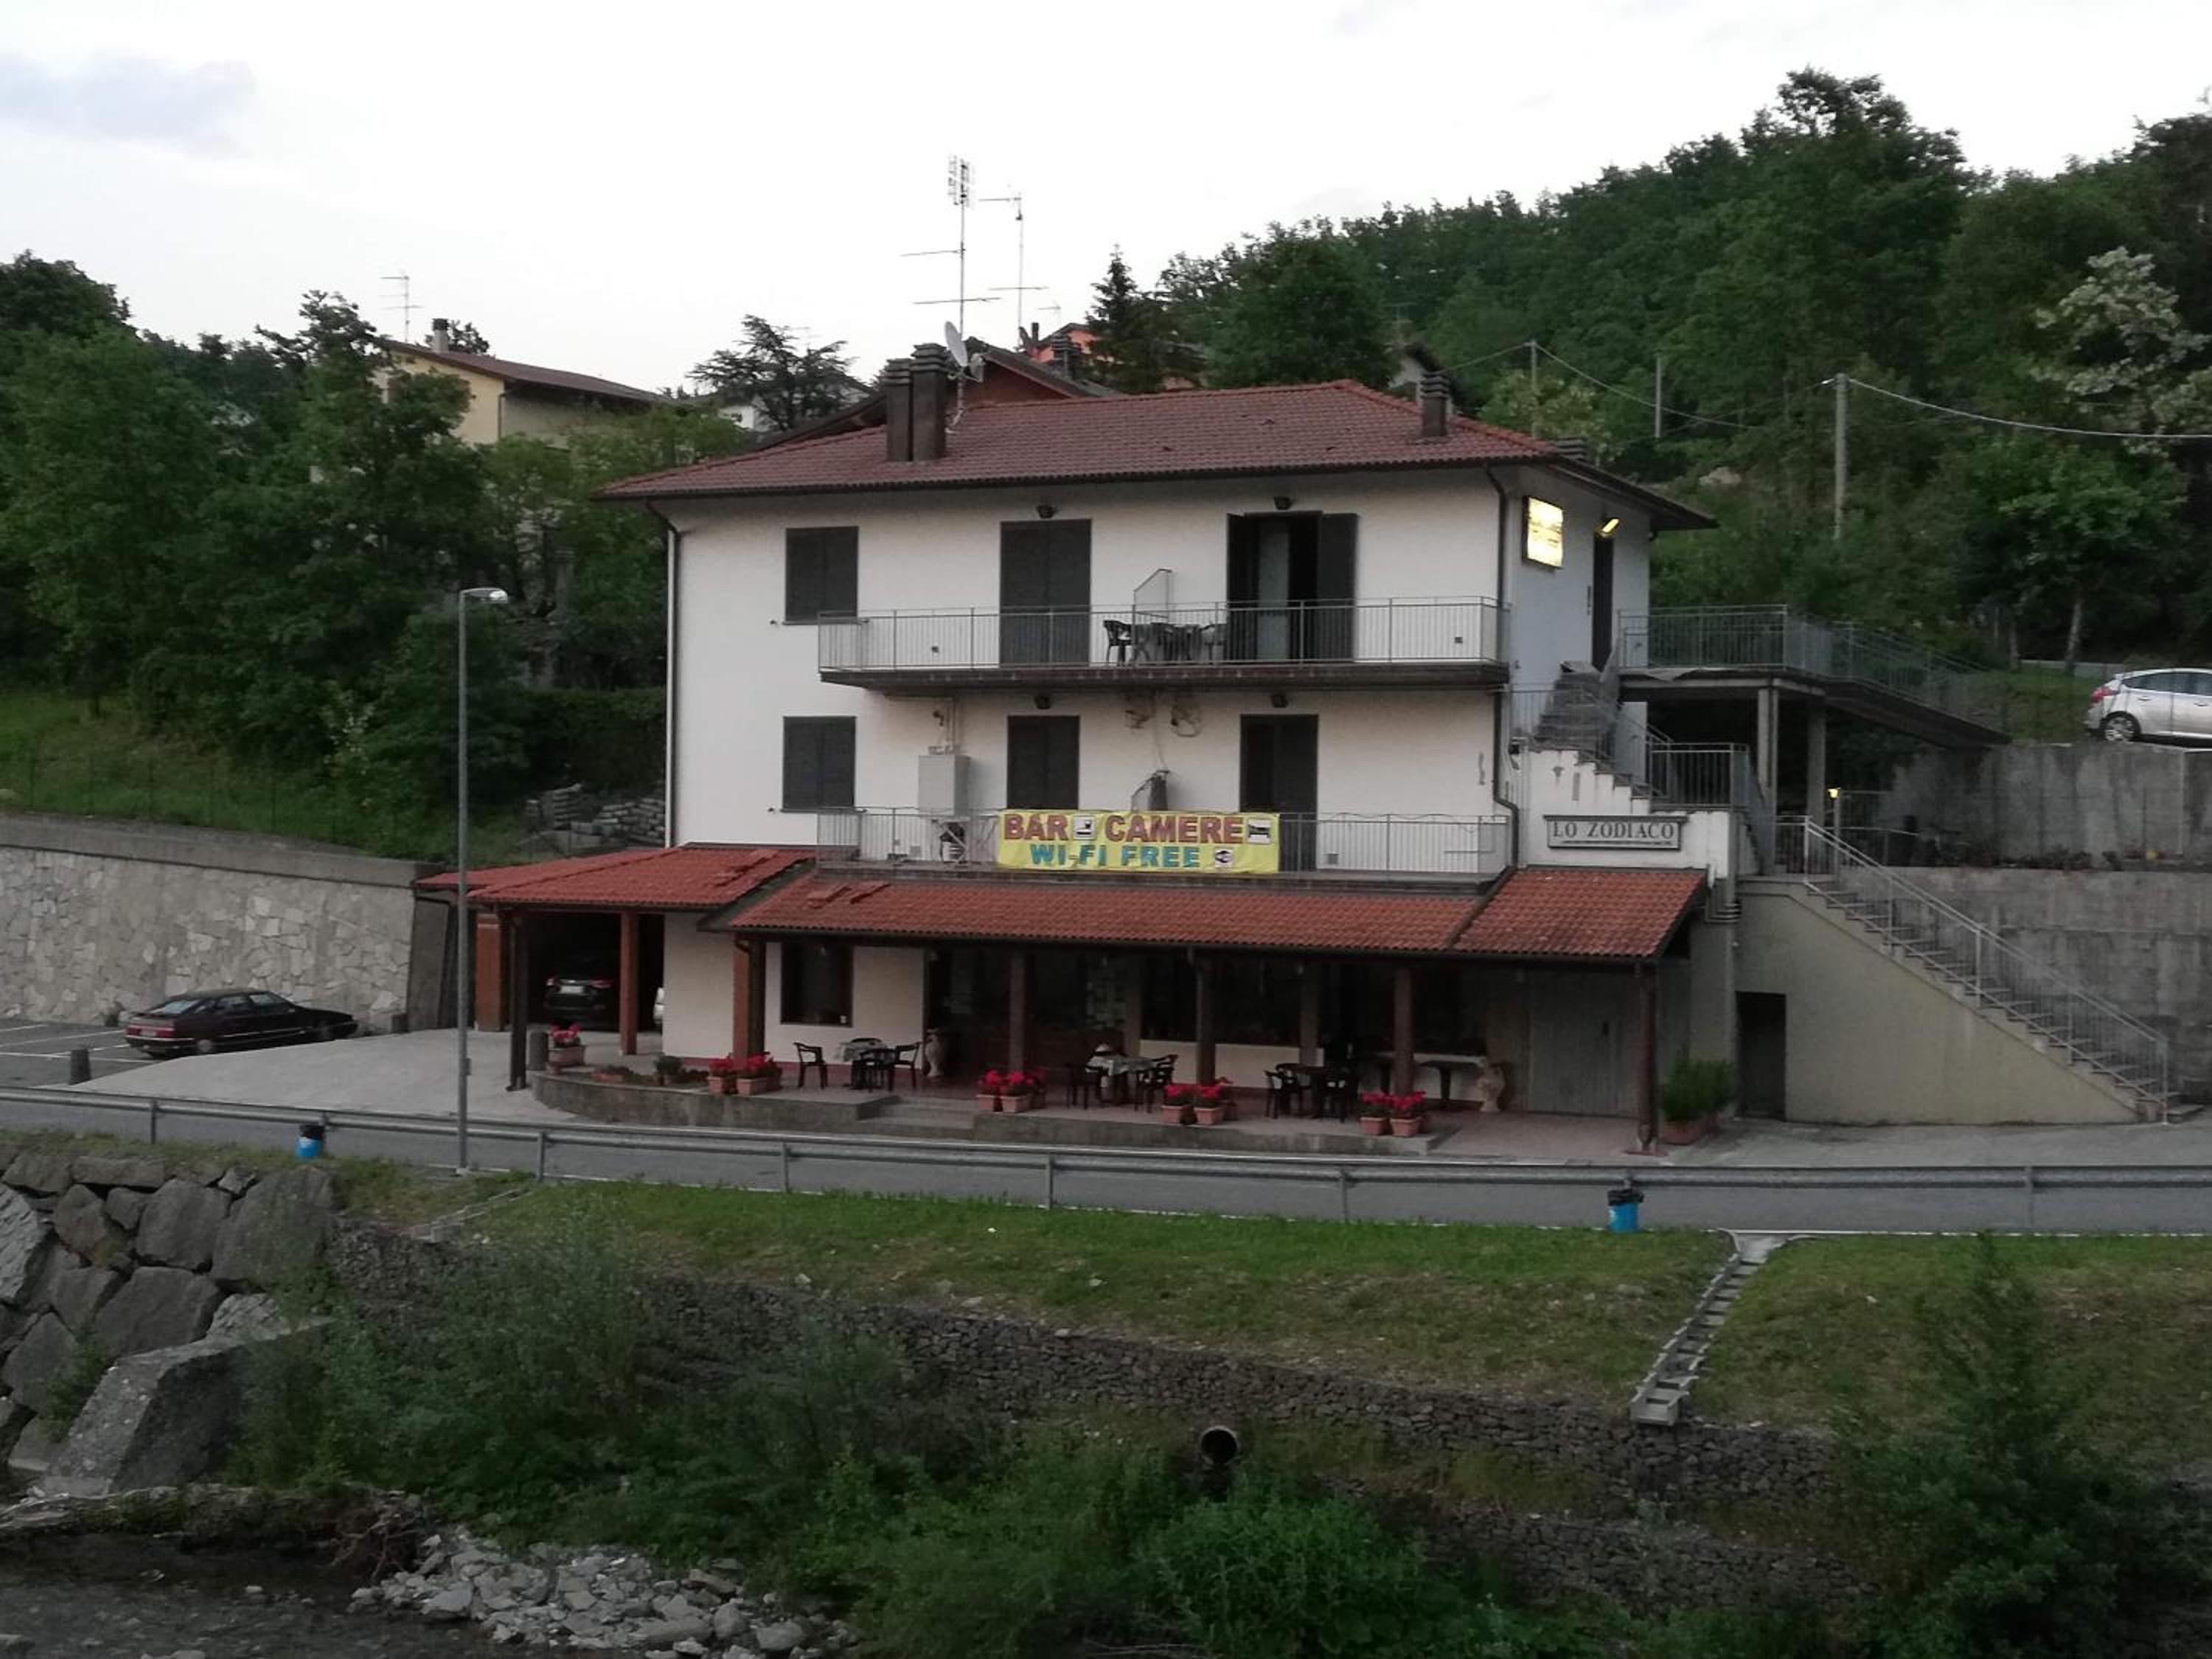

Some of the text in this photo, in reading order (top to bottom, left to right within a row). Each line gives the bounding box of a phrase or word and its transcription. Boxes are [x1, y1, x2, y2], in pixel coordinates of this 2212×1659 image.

[1004, 813, 1243, 844] BAR CAMERE
[1554, 822, 1674, 839] LO ZODIACO
[1030, 844, 1200, 868] WI-FI FREE
